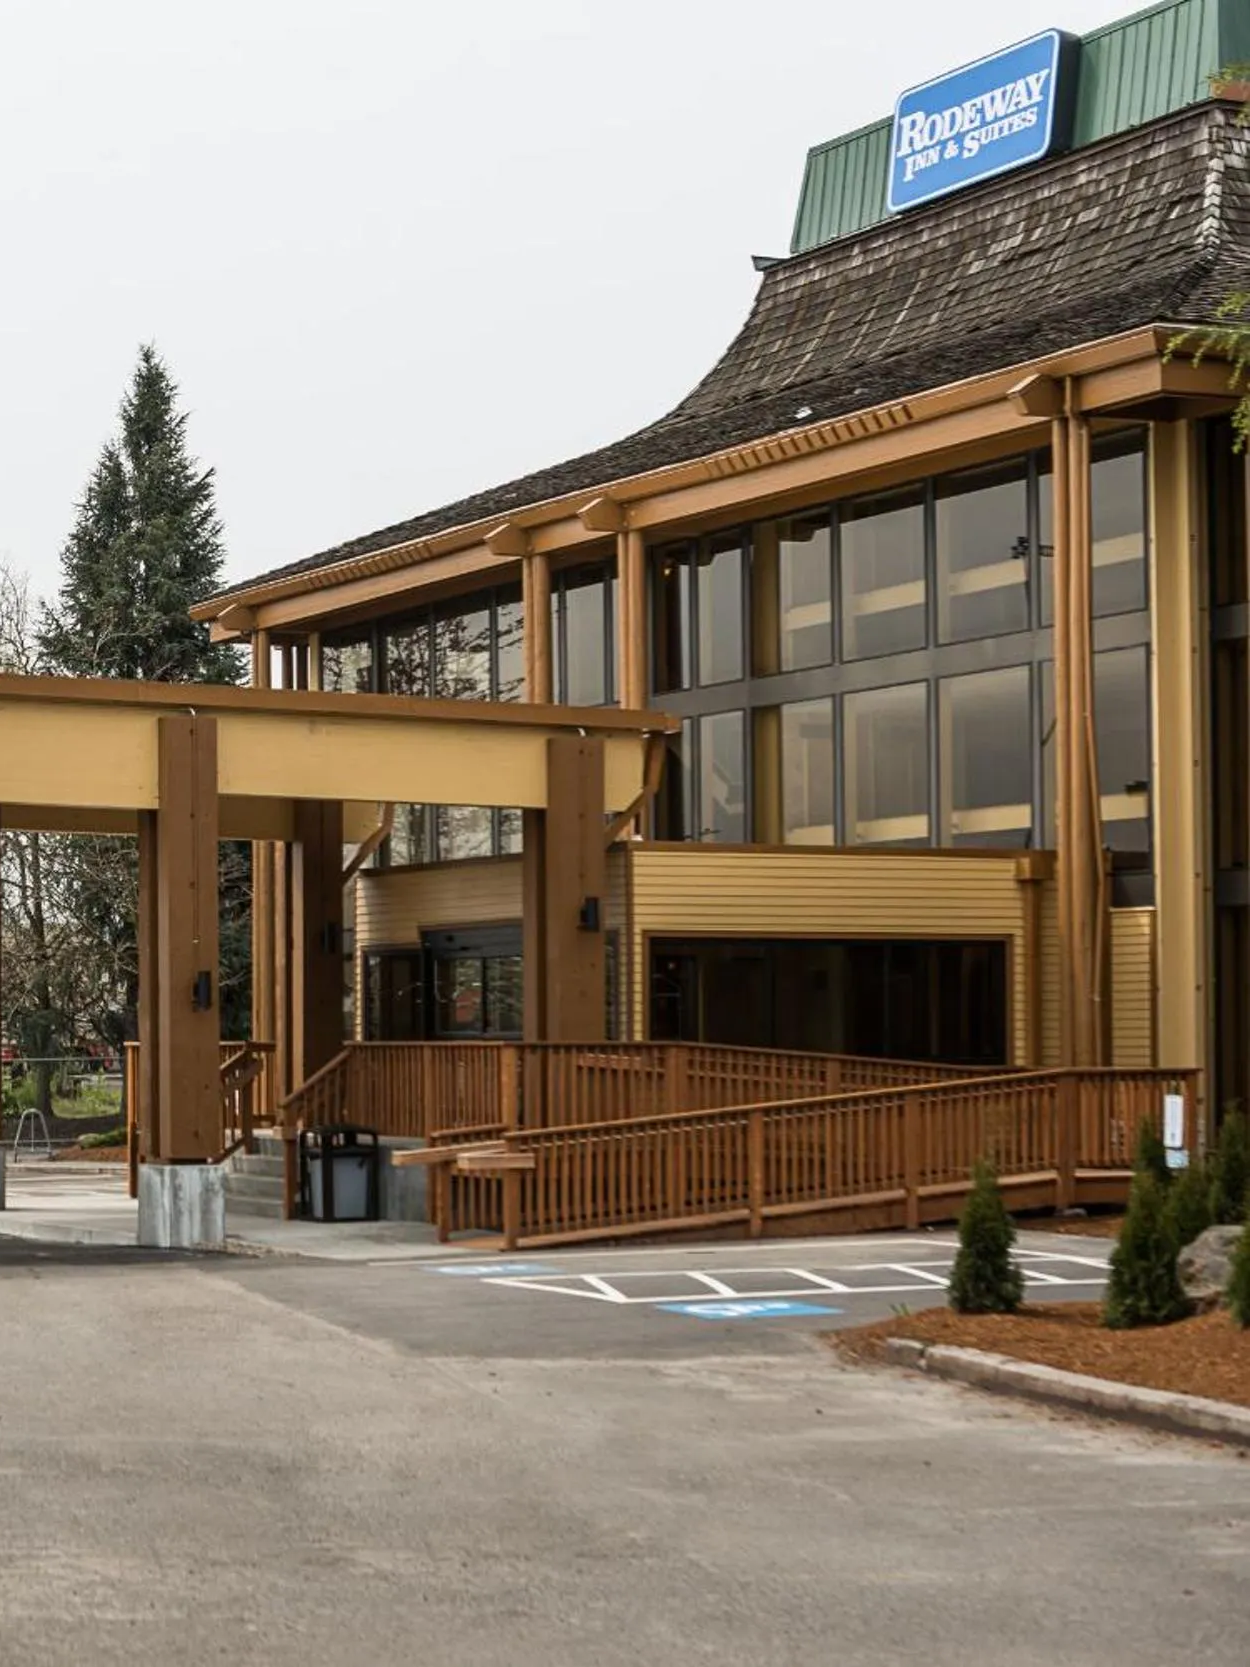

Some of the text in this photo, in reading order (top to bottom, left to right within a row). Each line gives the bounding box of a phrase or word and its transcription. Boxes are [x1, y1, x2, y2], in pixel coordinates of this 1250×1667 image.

[897, 68, 1049, 157] RODEWAY
[903, 107, 1037, 182] INN & SUITES
